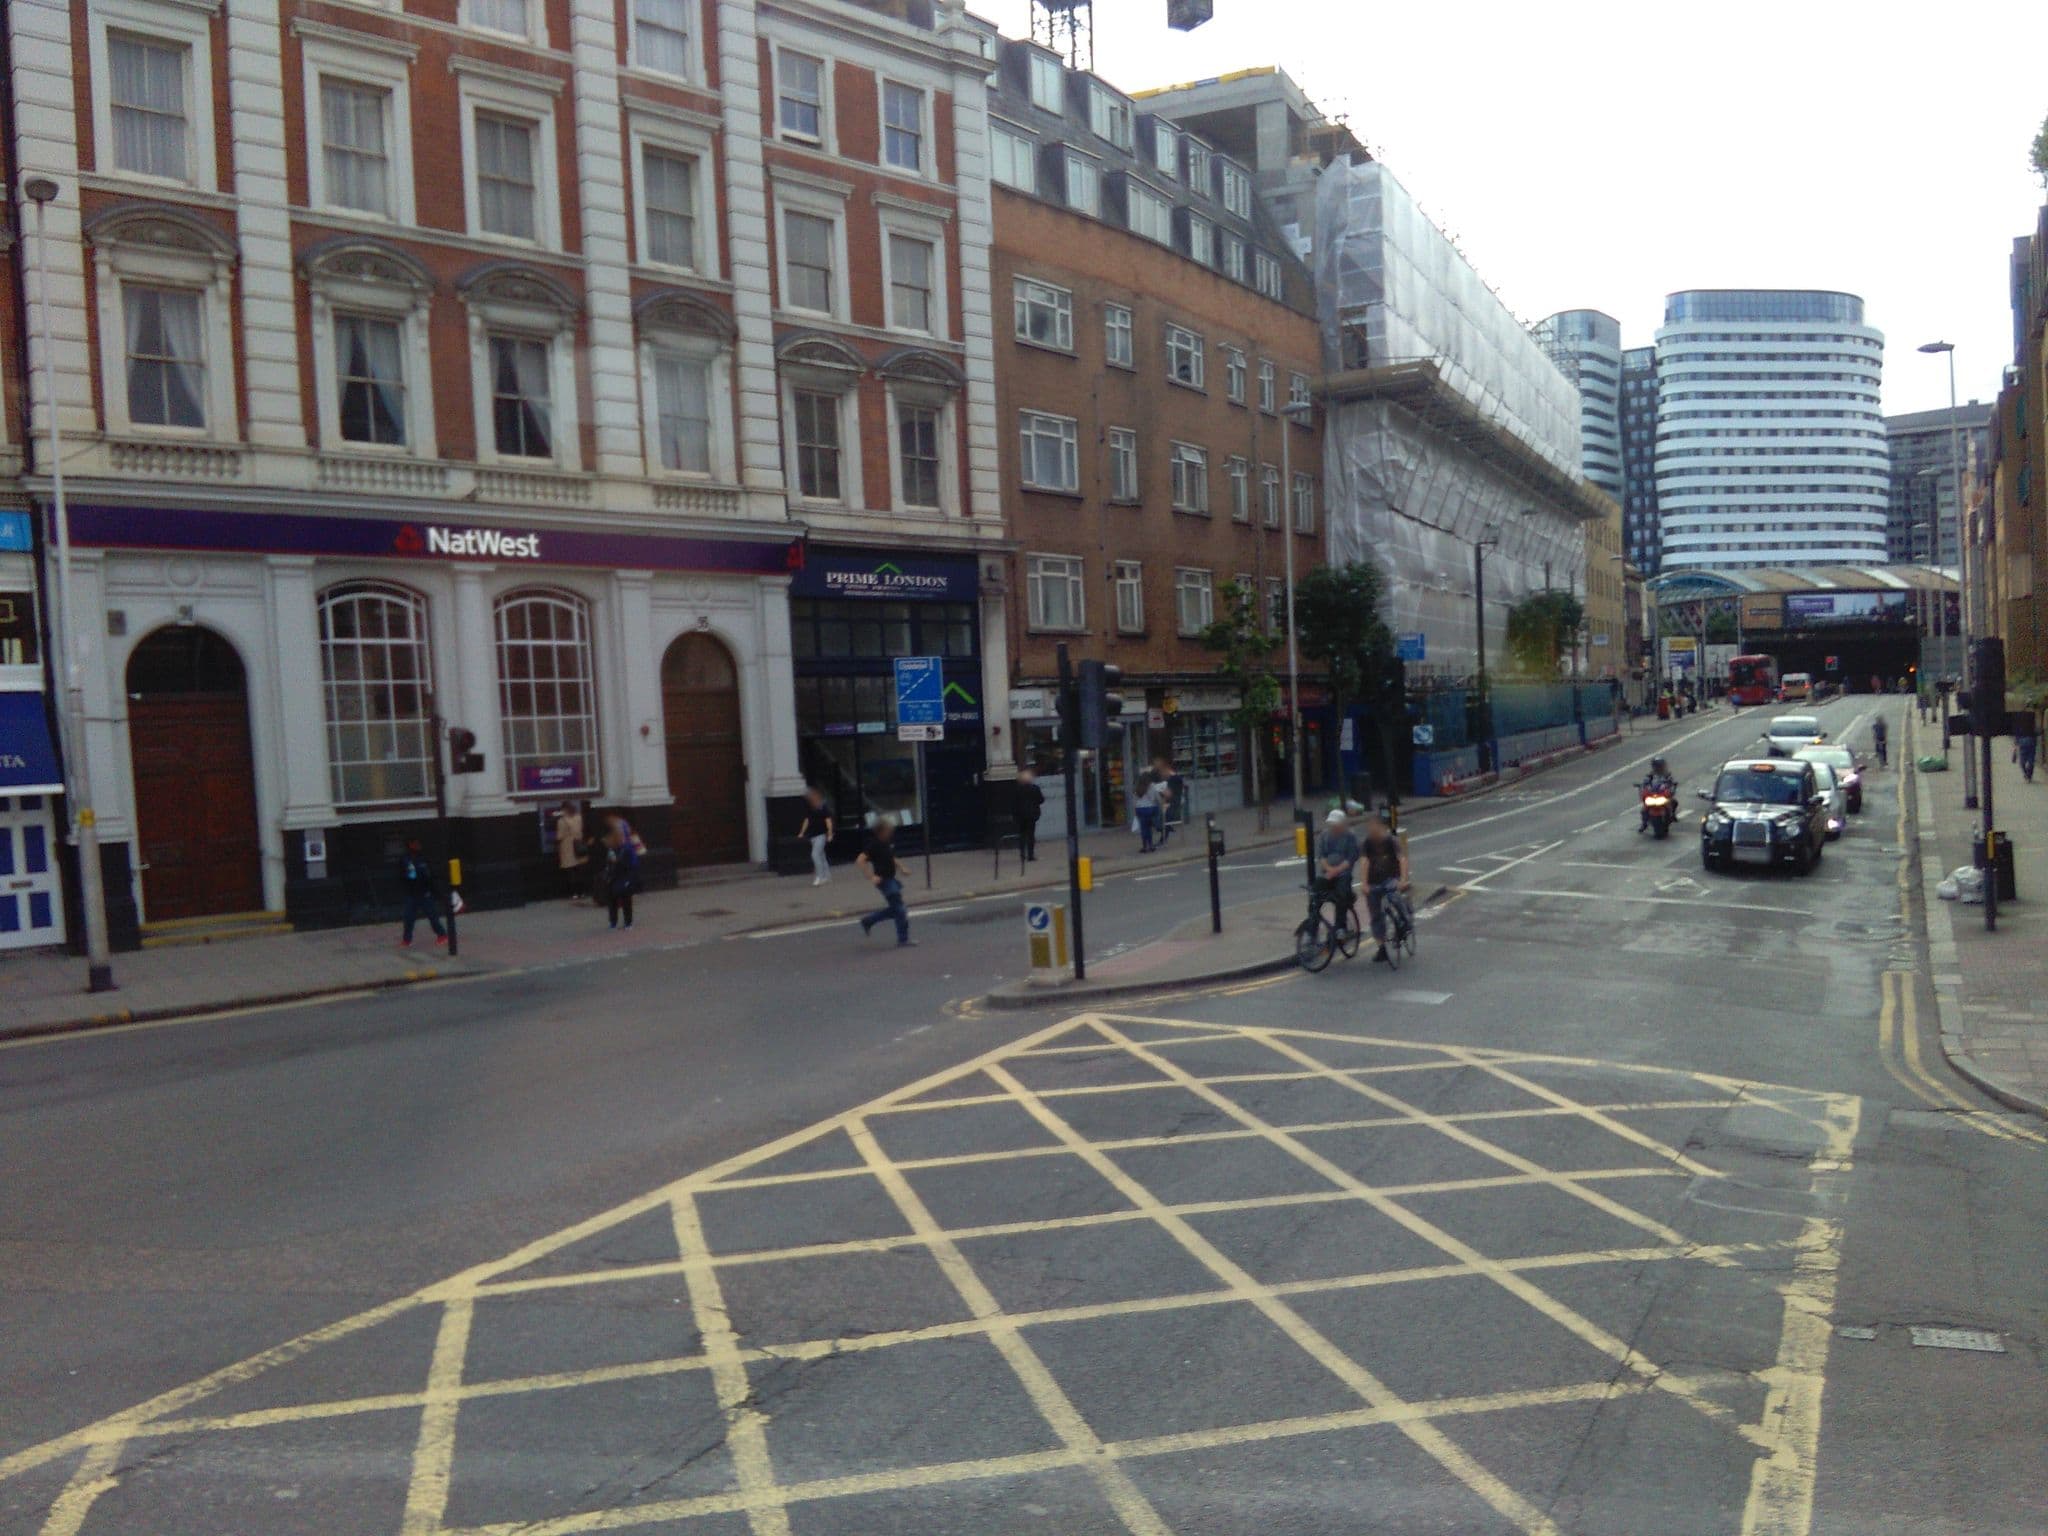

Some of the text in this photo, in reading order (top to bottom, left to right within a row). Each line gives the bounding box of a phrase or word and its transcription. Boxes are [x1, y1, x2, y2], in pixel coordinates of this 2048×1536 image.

[427, 526, 540, 558] NatWest
[826, 572, 879, 585] PRIME
[884, 575, 948, 587] LONDON
